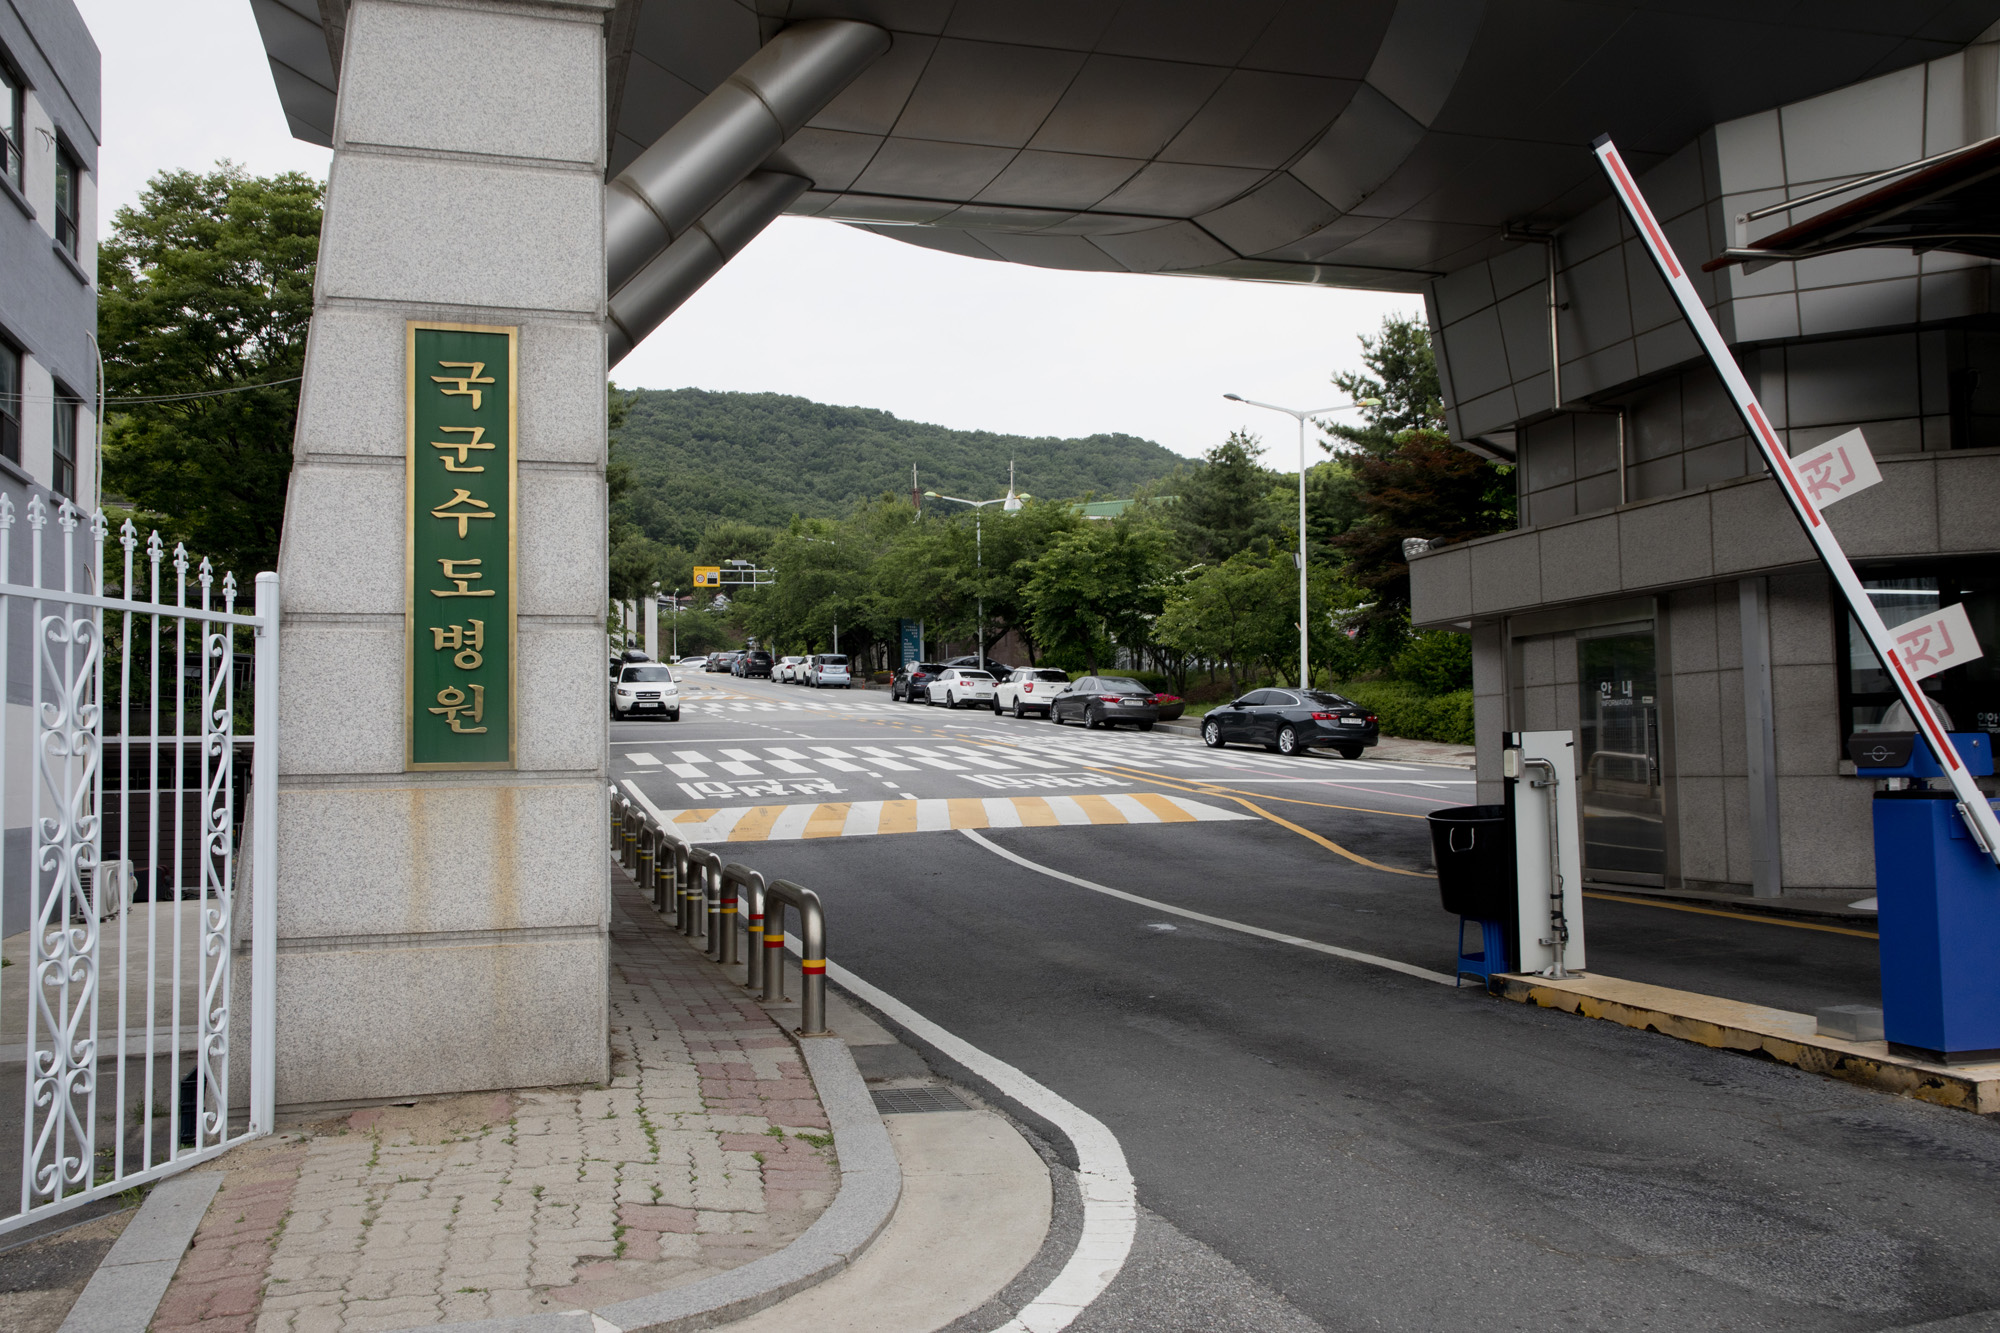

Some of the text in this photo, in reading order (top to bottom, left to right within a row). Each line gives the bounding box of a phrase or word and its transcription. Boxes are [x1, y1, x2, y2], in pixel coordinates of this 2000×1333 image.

[428, 361, 496, 734] 국군수도병원
[676, 778, 848, 800] 천천히
[956, 772, 1134, 789] 천천히
